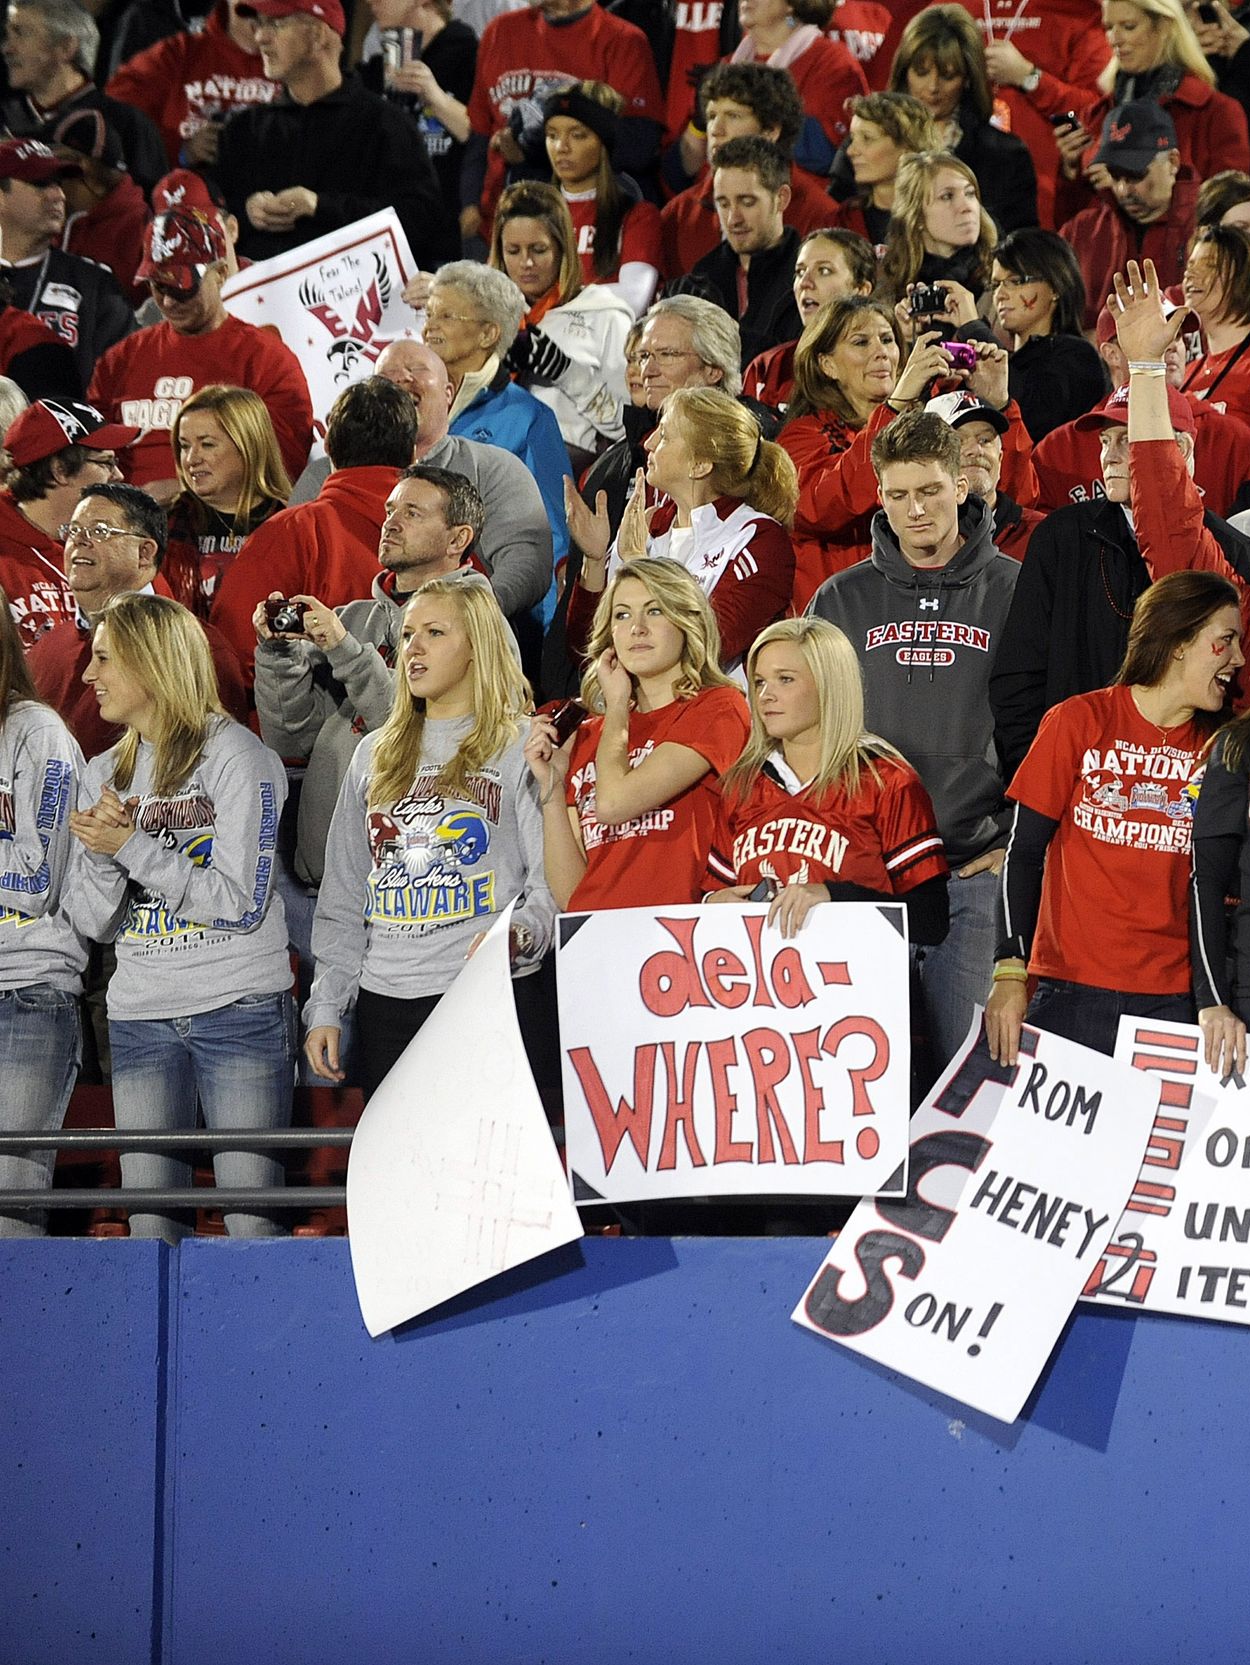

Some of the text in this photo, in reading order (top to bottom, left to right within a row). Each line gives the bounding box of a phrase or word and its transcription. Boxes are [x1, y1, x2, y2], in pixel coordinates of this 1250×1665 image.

[154, 376, 194, 400] GO
[865, 621, 991, 652] EASTERN
[903, 652, 947, 662] EAGLES
[391, 798, 446, 825] Eagles
[732, 818, 849, 875] EASTERN
[378, 864, 464, 891] Blue Hens
[364, 874, 493, 918] DELAWARE
[145, 930, 207, 949] 2011
[639, 915, 852, 1018] dela-
[567, 1015, 890, 1177] WHERE?
